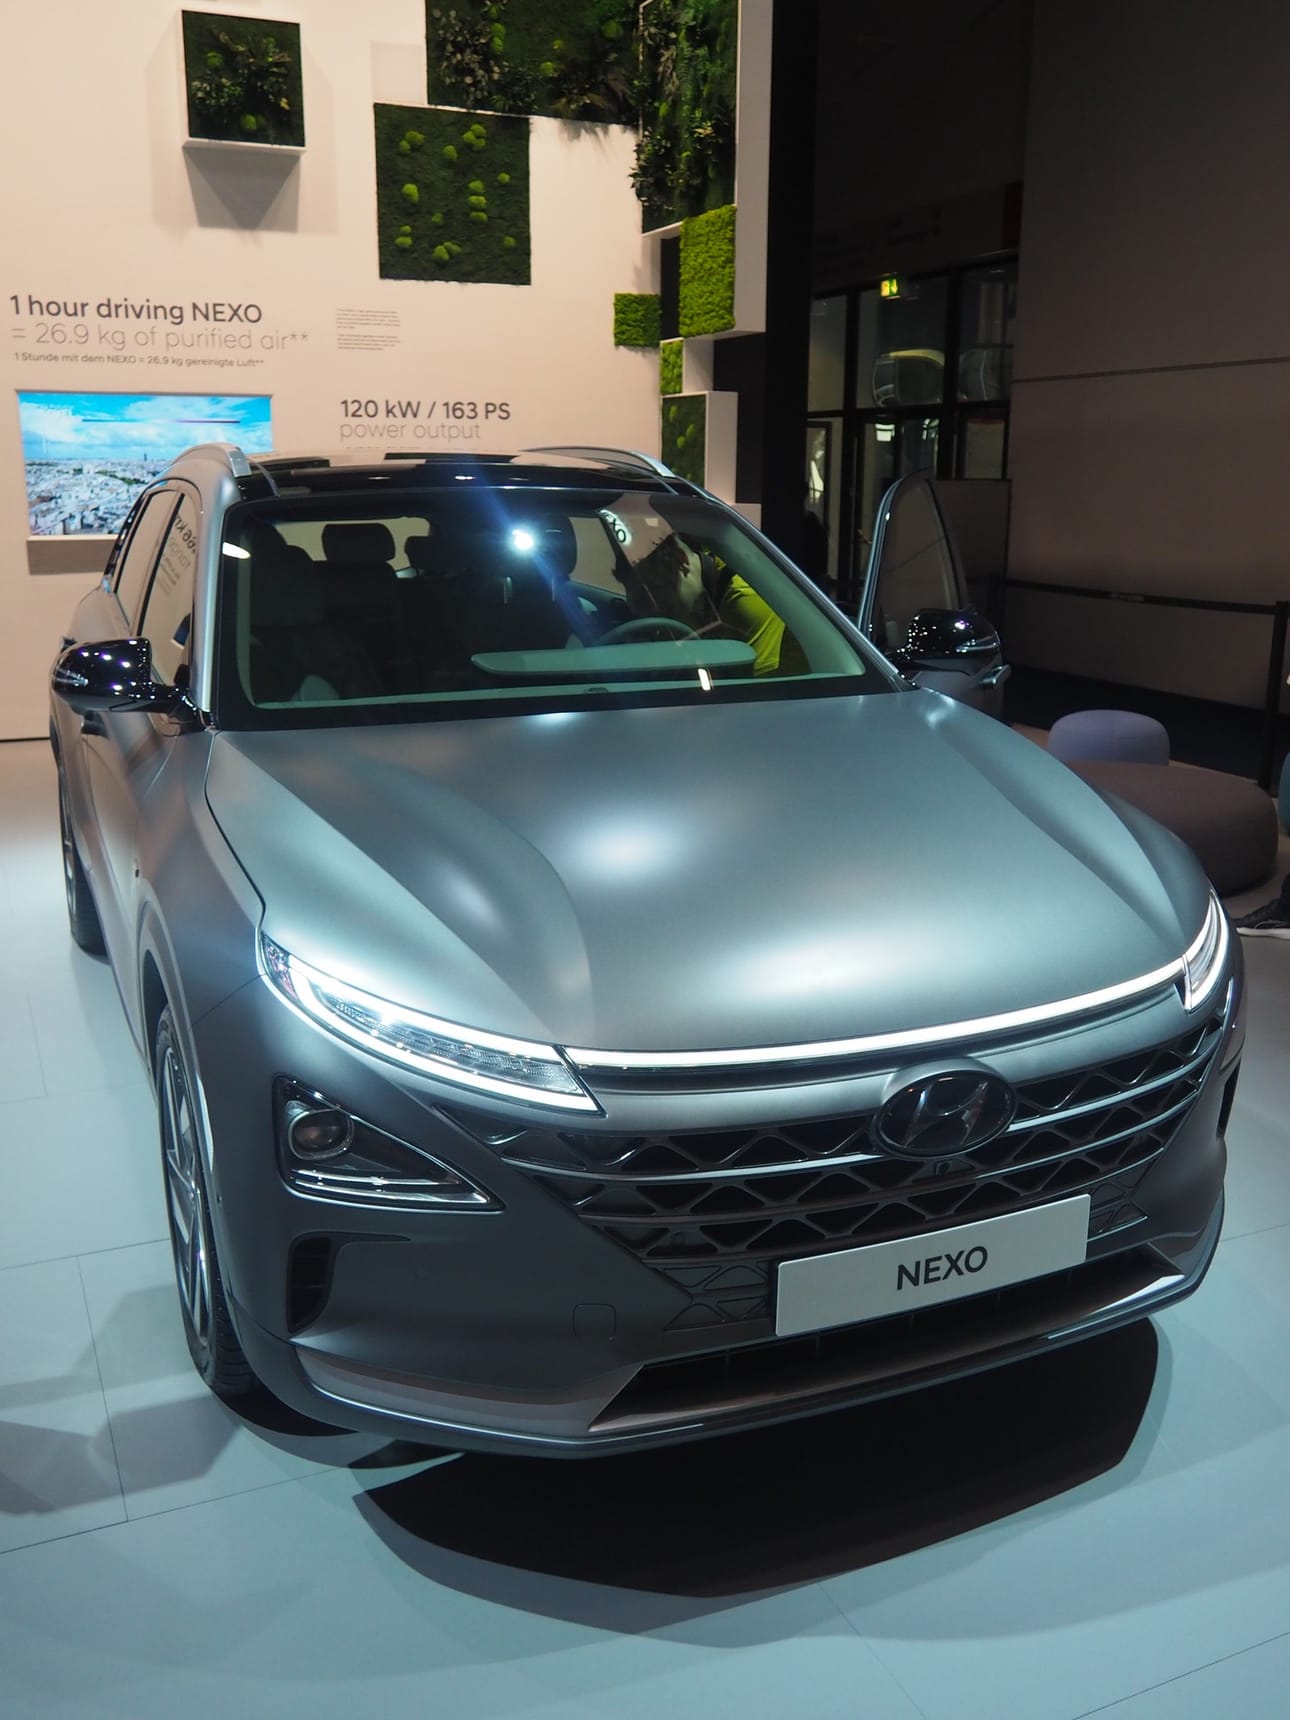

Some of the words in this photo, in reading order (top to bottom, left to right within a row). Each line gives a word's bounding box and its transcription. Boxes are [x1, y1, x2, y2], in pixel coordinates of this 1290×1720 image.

[9, 294, 21, 315] 1
[28, 294, 89, 318] hour
[96, 297, 184, 326] driving
[192, 301, 263, 324] NEXO
[34, 322, 90, 345] 26.9
[98, 324, 126, 351] kg
[133, 326, 157, 347] of
[165, 327, 252, 352] purified
[21, 352, 60, 363] Stunde
[62, 353, 79, 363] mit
[81, 353, 106, 363] dem
[107, 354, 137, 365] NEXO
[171, 355, 184, 368] kg
[340, 399, 379, 418] 120
[385, 399, 421, 419] kW
[427, 400, 437, 420] /
[442, 401, 478, 420] 163
[484, 402, 511, 420] PS
[340, 423, 406, 443] power
[413, 422, 481, 443] output
[895, 1244, 989, 1292] NEXO
